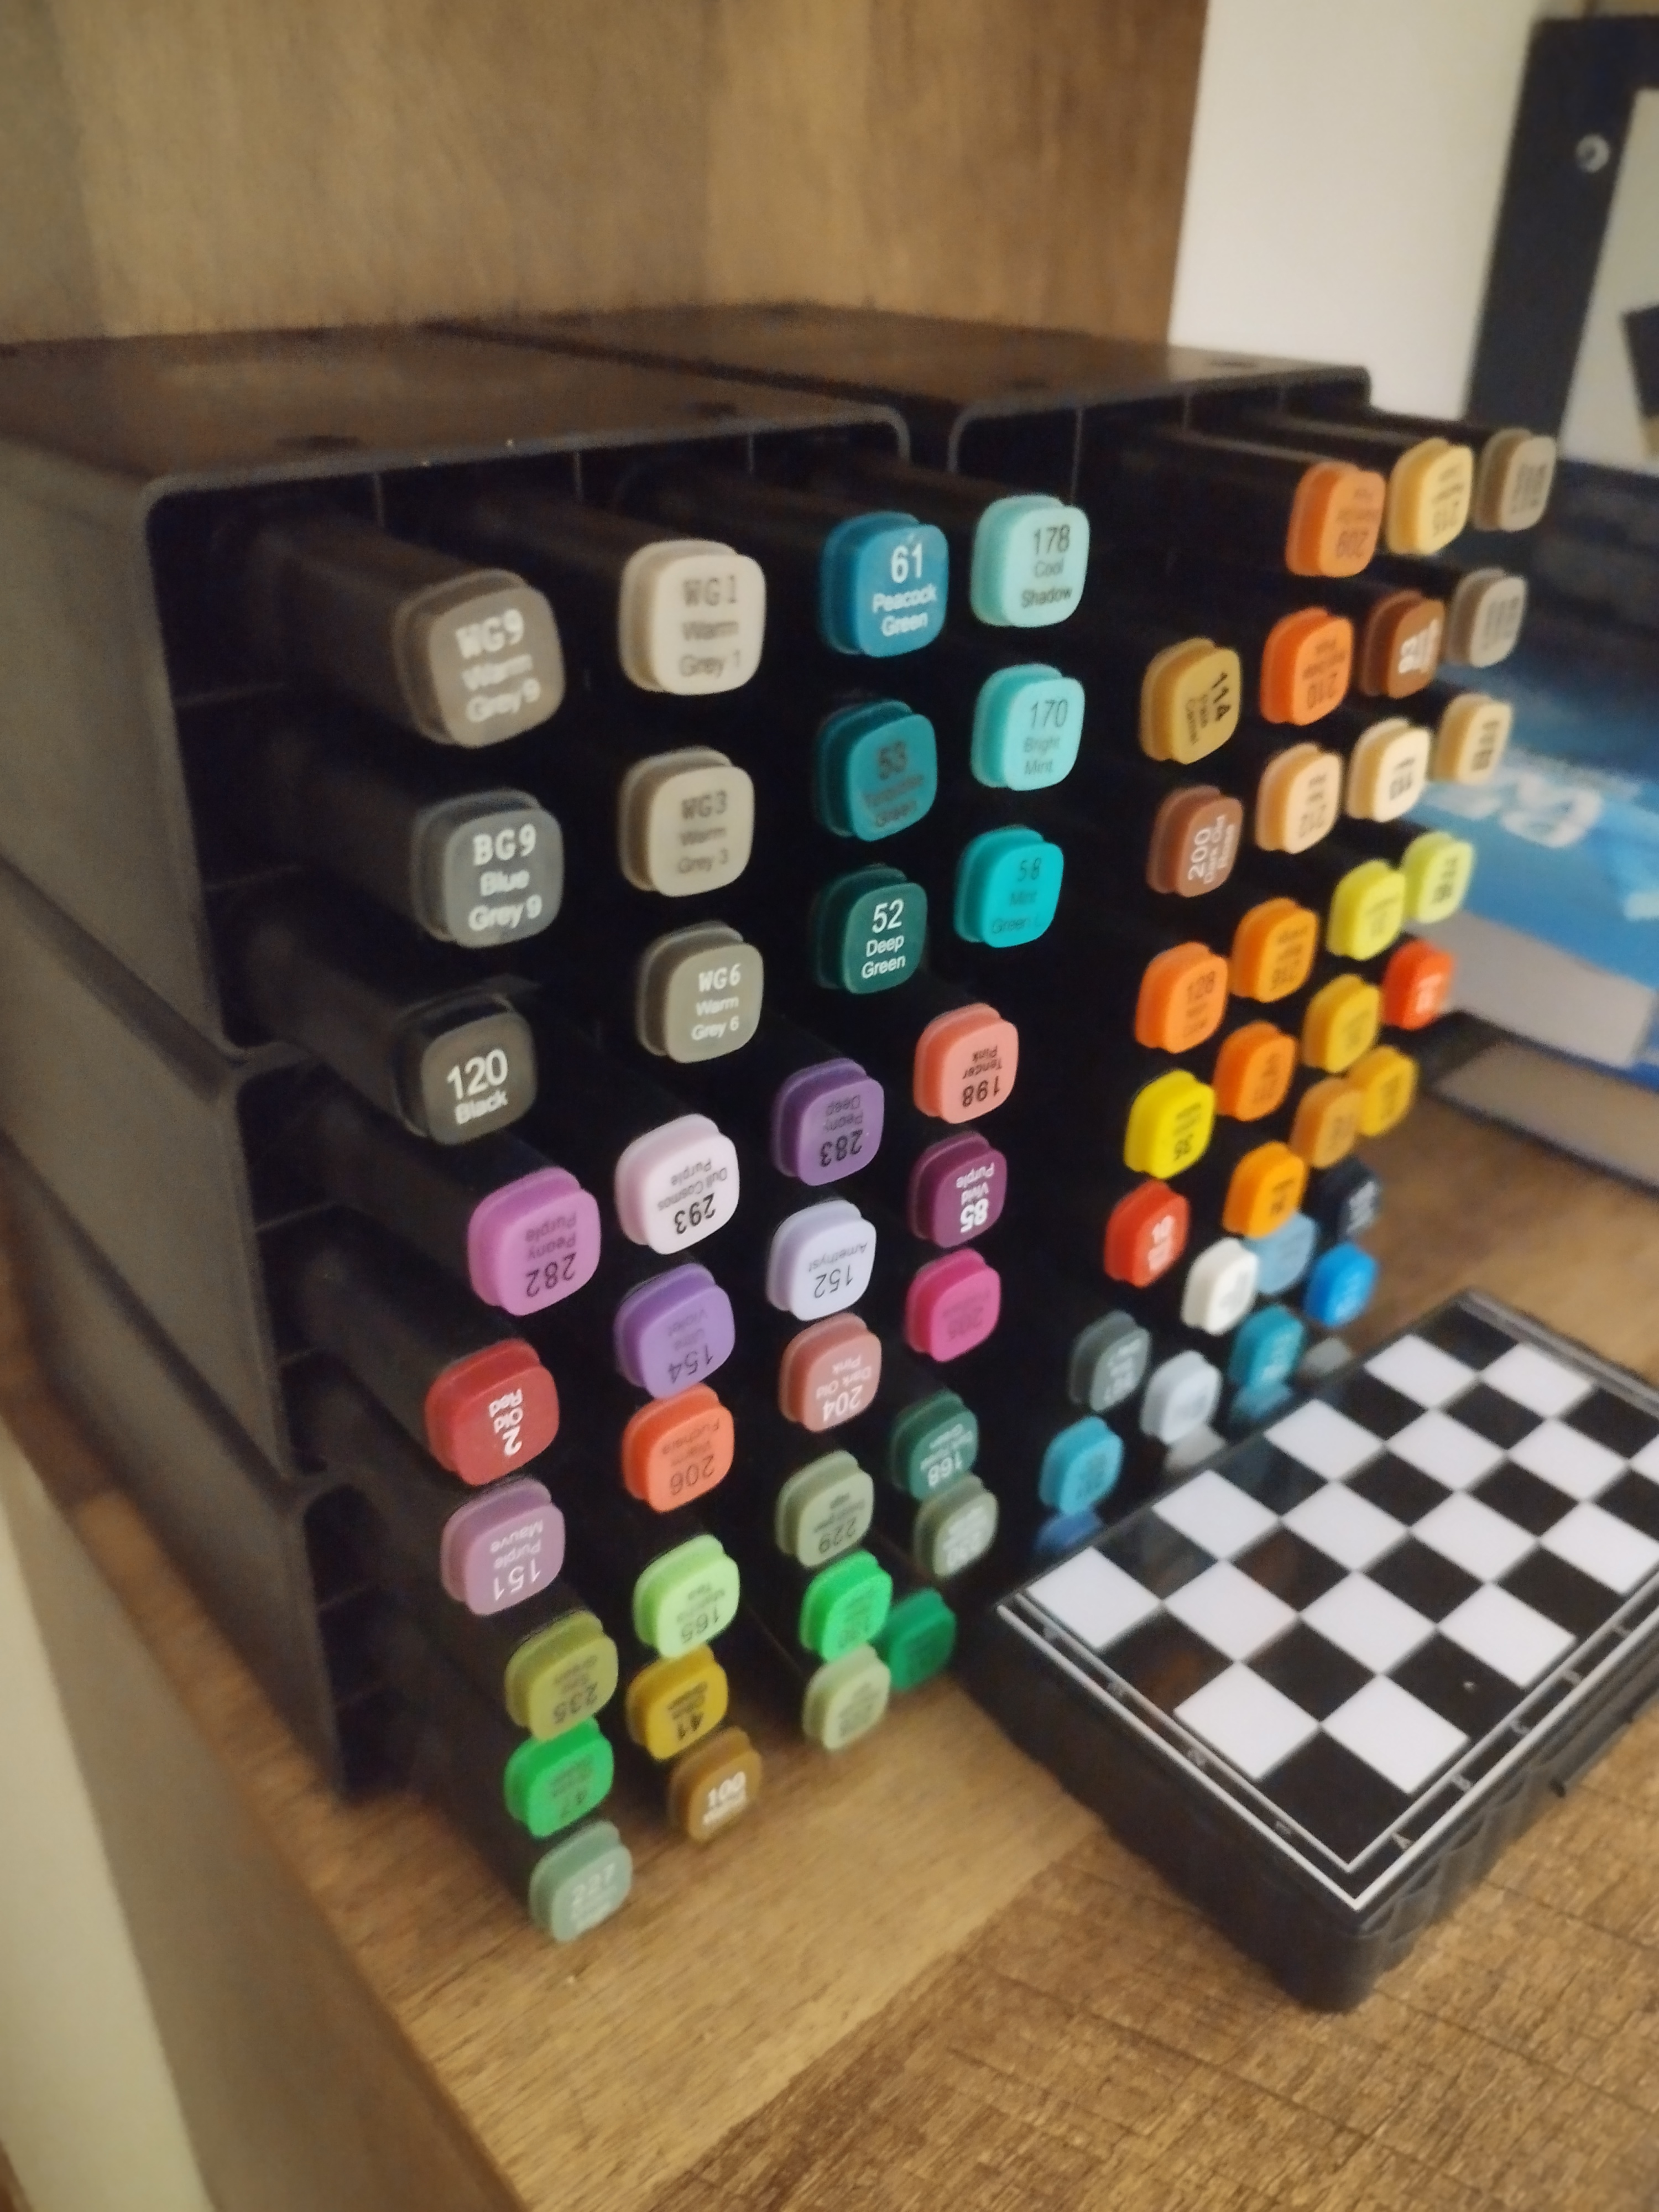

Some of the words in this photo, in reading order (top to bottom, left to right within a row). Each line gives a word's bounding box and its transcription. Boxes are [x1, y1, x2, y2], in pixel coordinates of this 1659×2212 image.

[1033, 524, 1071, 556] 178
[890, 543, 924, 584] 61
[682, 575, 739, 608] WG1
[872, 583, 938, 614] Peacock
[1021, 586, 1073, 609] Shadow
[880, 612, 929, 637] Green
[1031, 698, 1069, 729] 170
[472, 823, 537, 866] BG9
[1187, 828, 1212, 881] 200
[526, 894, 542, 919] 9
[872, 899, 905, 933] 52
[865, 935, 905, 958] Deep
[698, 963, 742, 993] WG6
[860, 954, 906, 979] Green
[695, 995, 740, 1017] Warm
[690, 1020, 727, 1041] Grey
[728, 1015, 740, 1032] 6
[446, 1048, 509, 1100] 120
[453, 1088, 509, 1125] Black
[962, 1076, 1000, 1108] 198
[819, 1129, 863, 1168] 283
[670, 1157, 713, 1187] Purple
[956, 1161, 995, 1189] Purple
[674, 1193, 716, 1235] 293
[959, 1197, 989, 1234] 85
[525, 1251, 577, 1298] 282
[813, 1263, 854, 1299] 152
[667, 1343, 713, 1385] 154
[823, 1384, 863, 1423] 204
[502, 1425, 523, 1457] 2
[669, 1454, 715, 1496] 206
[489, 1520, 544, 1554] Mauve
[493, 1541, 542, 1571] Purple
[492, 1558, 541, 1601] 151
